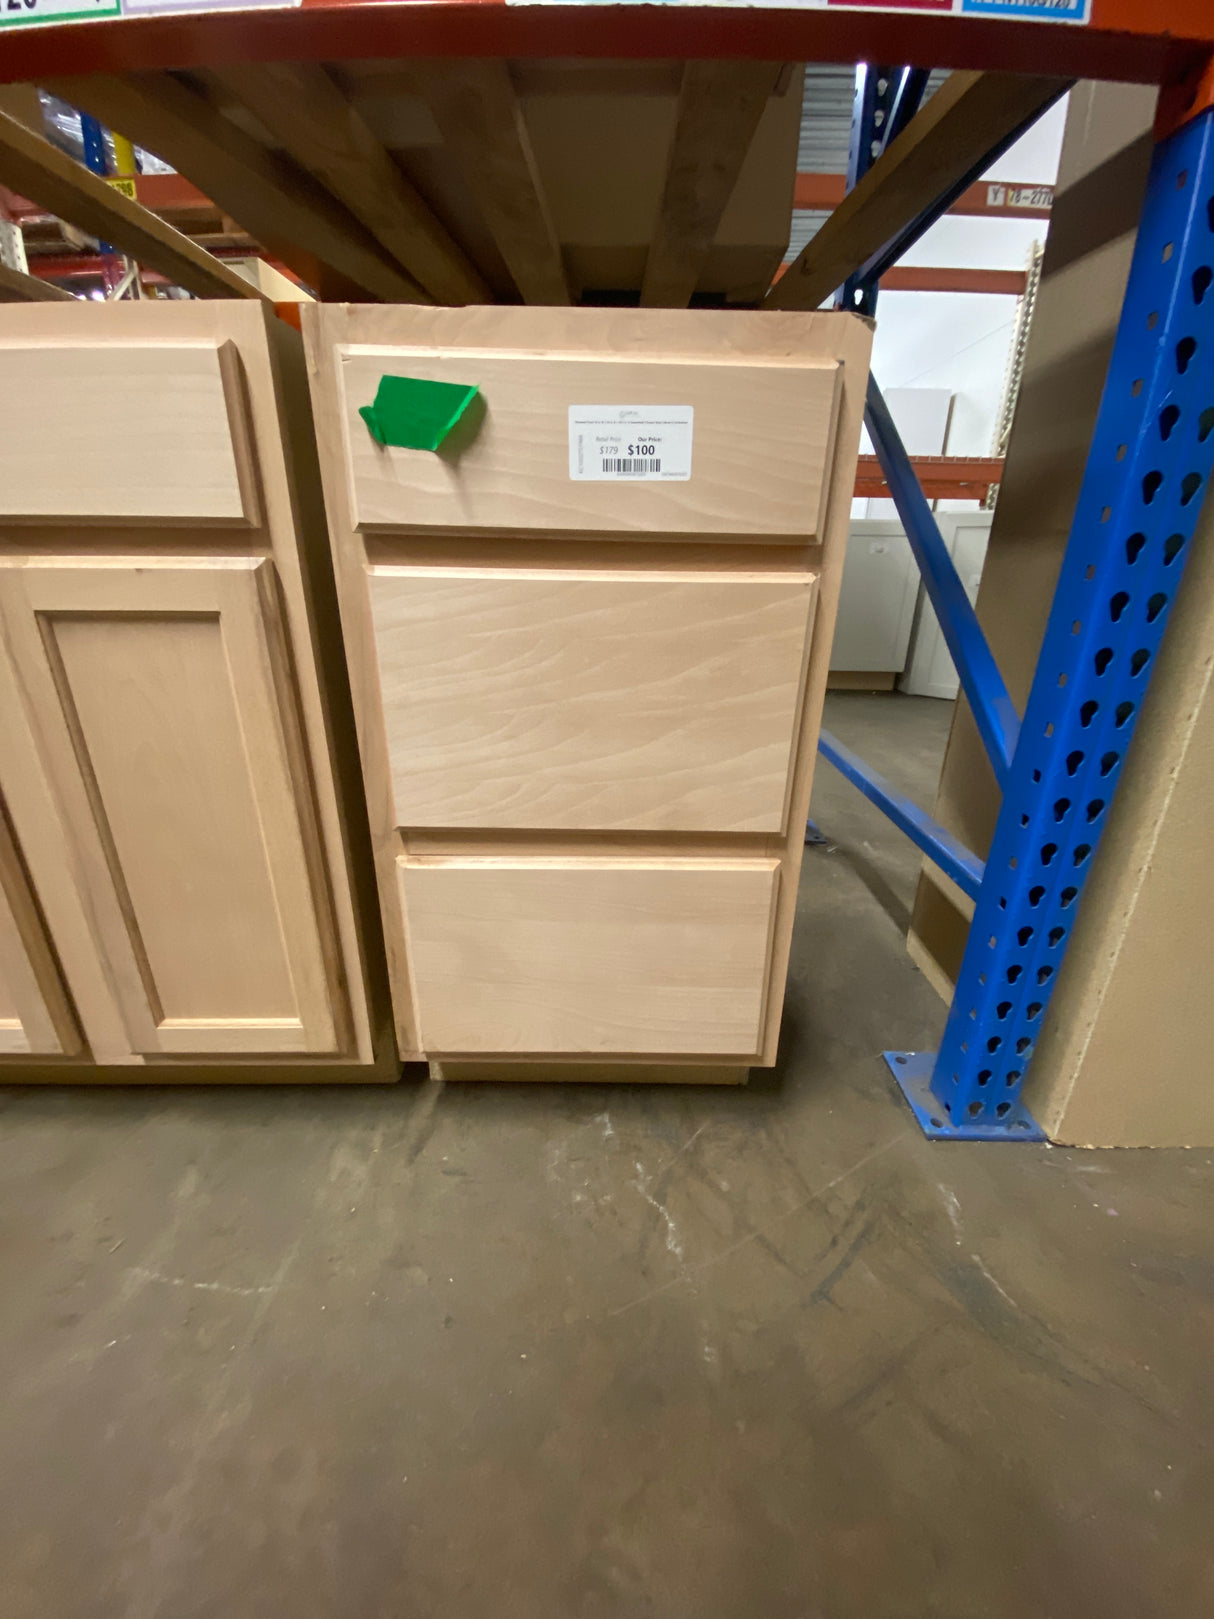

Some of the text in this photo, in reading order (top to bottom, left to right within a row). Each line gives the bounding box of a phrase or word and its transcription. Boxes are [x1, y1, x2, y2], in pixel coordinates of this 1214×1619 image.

[992, 186, 1001, 203] Y
[600, 444, 655, 456] $179 $100
